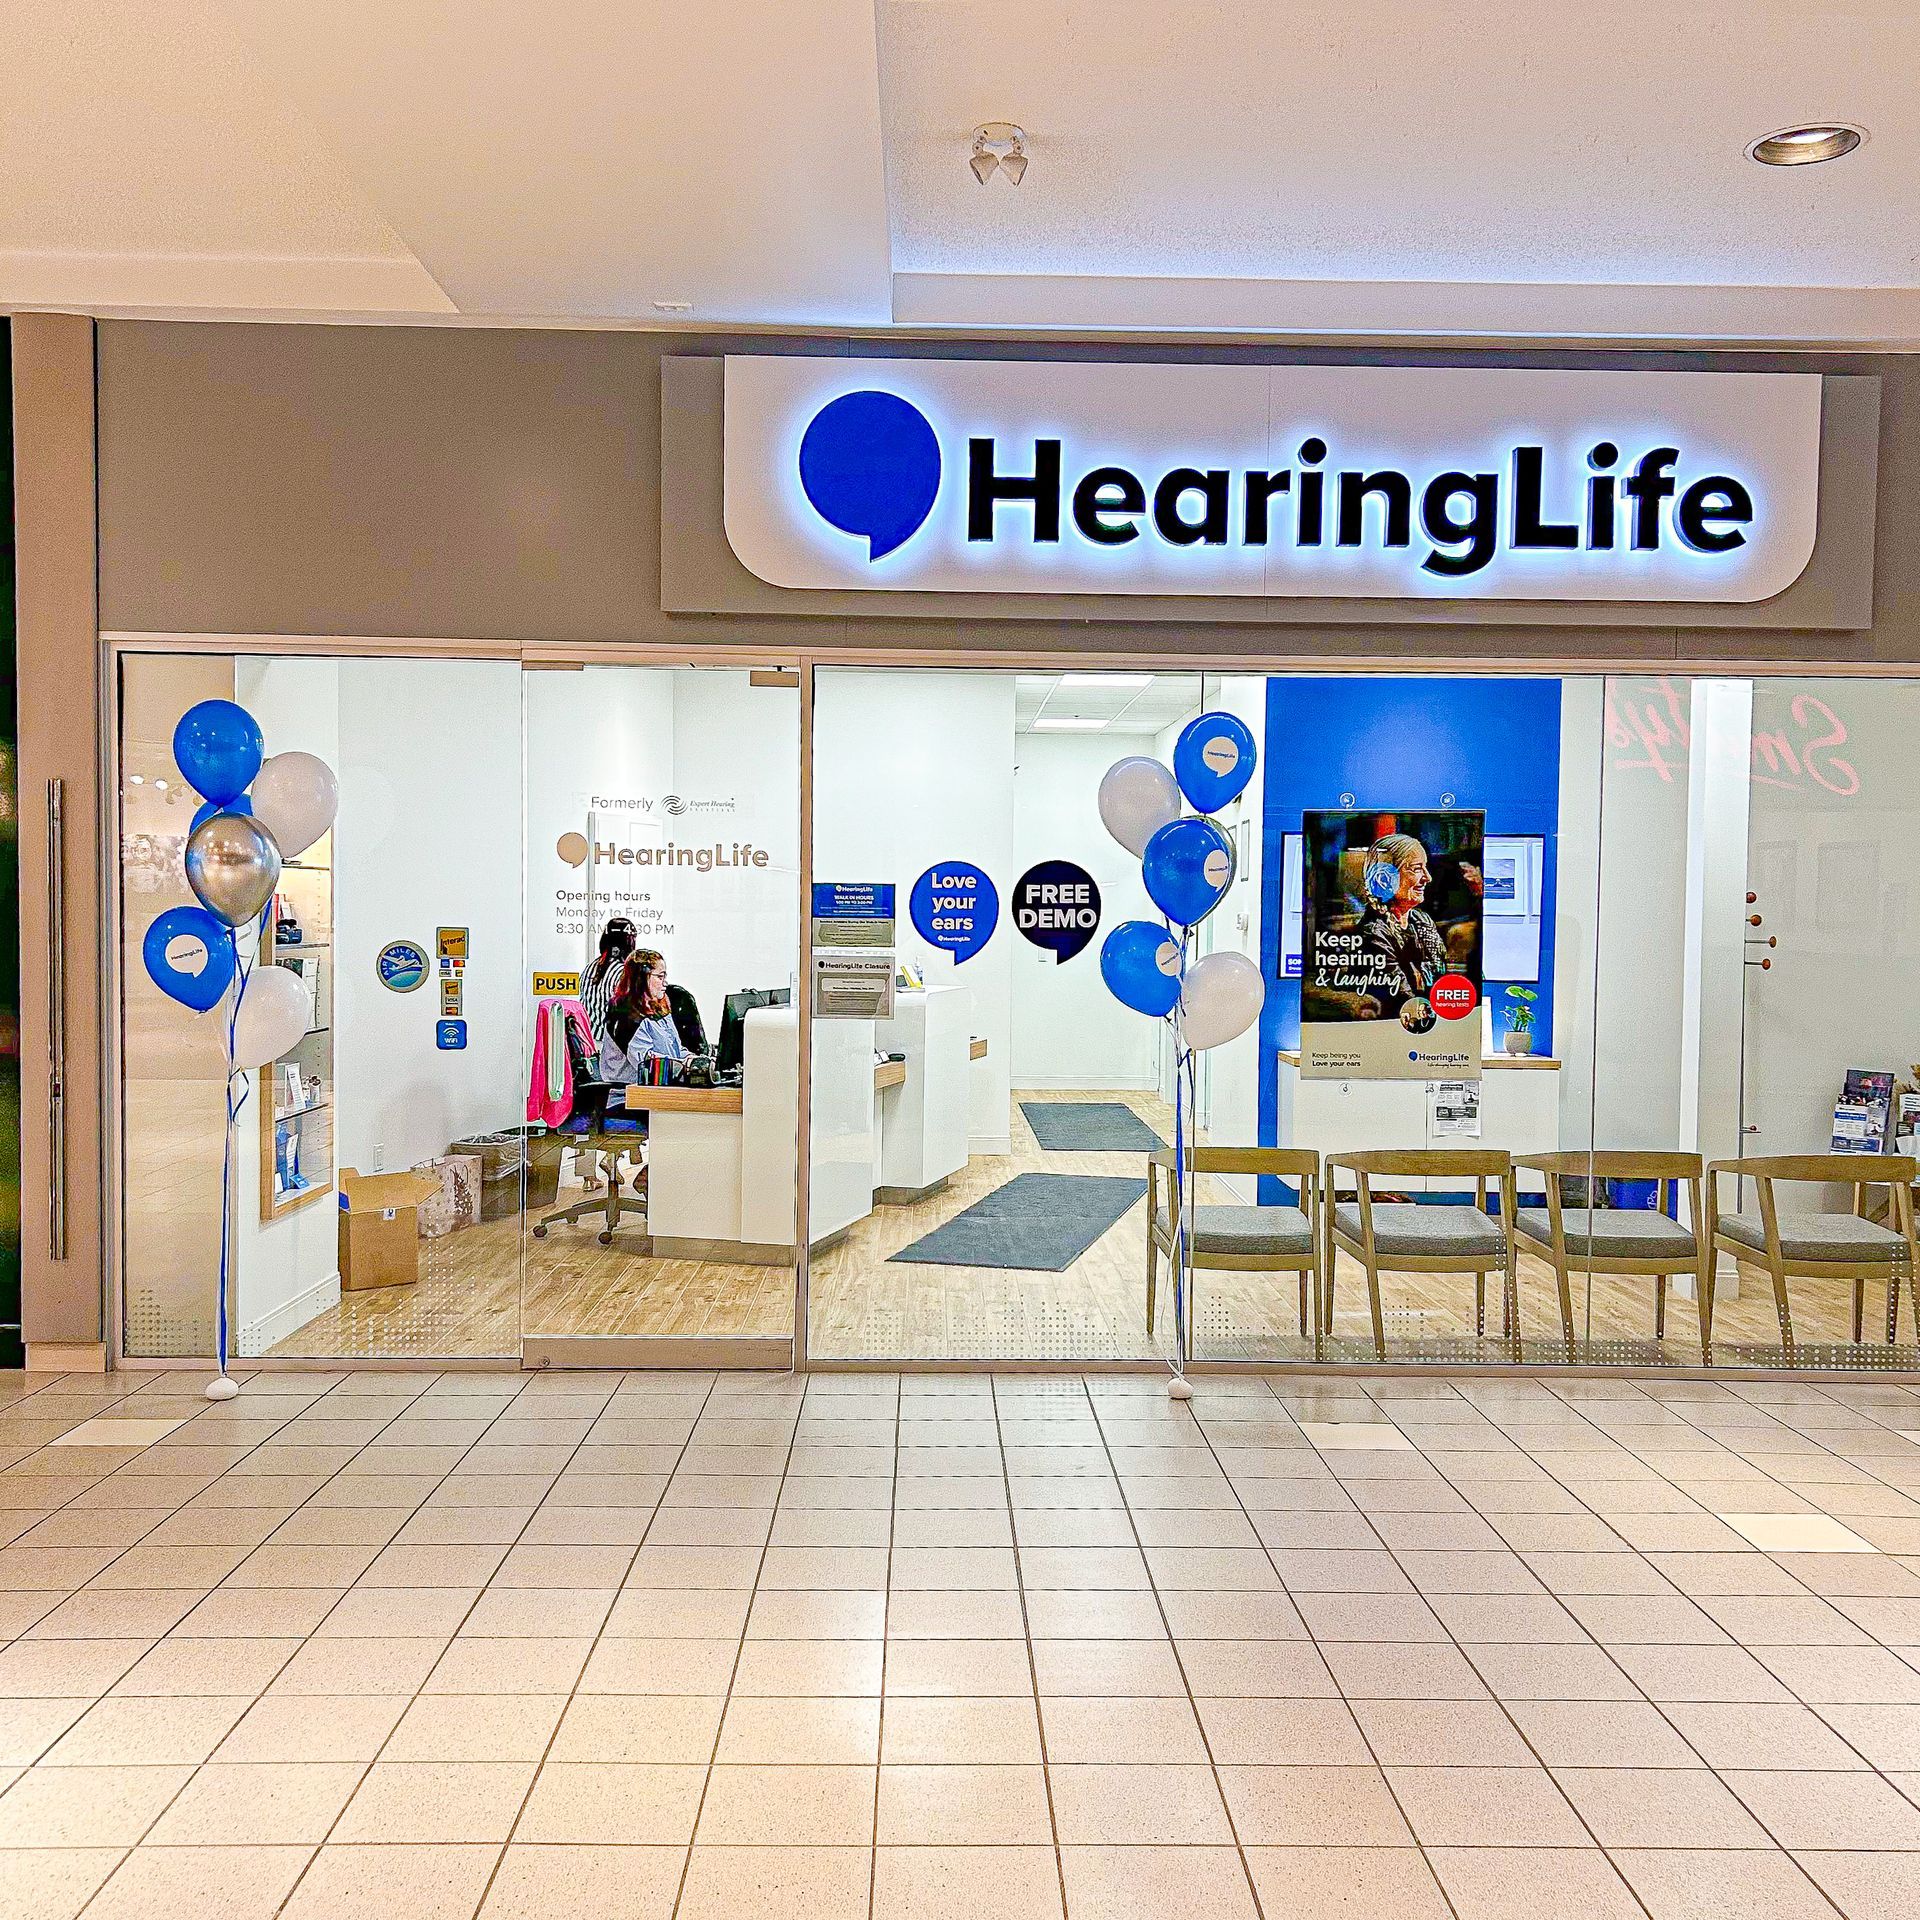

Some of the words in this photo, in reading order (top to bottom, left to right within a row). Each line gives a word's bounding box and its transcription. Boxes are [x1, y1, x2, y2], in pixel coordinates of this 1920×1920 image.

[968, 437, 1754, 577] HearingLife
[591, 796, 653, 812] Formerly
[689, 800, 710, 808] Expert
[711, 800, 735, 808] Hearing
[594, 842, 769, 873] HearingLife
[931, 873, 977, 889] Love
[556, 890, 611, 903] Opening
[615, 891, 651, 901] hours
[1026, 884, 1090, 904] FREE
[931, 896, 977, 914] your
[556, 907, 606, 920] Monday
[610, 908, 621, 918] to
[625, 907, 664, 920] Friday
[1019, 908, 1097, 929] DEMO
[556, 923, 584, 934] 8:30
[589, 924, 608, 935] AM
[655, 924, 675, 935] PM
[931, 916, 974, 931] ears
[1315, 931, 1363, 950] Keep
[381, 961, 390, 976] AIR
[389, 947, 416, 958] MILES
[826, 962, 863, 970] HearingLife
[1315, 951, 1386, 970] hearing
[536, 977, 576, 990] PUSH
[1315, 968, 1330, 987] &
[1333, 968, 1401, 997] laughing
[1436, 989, 1470, 1000] FREE
[1330, 1052, 1347, 1060] being
[1419, 1053, 1470, 1063] HearingLife
